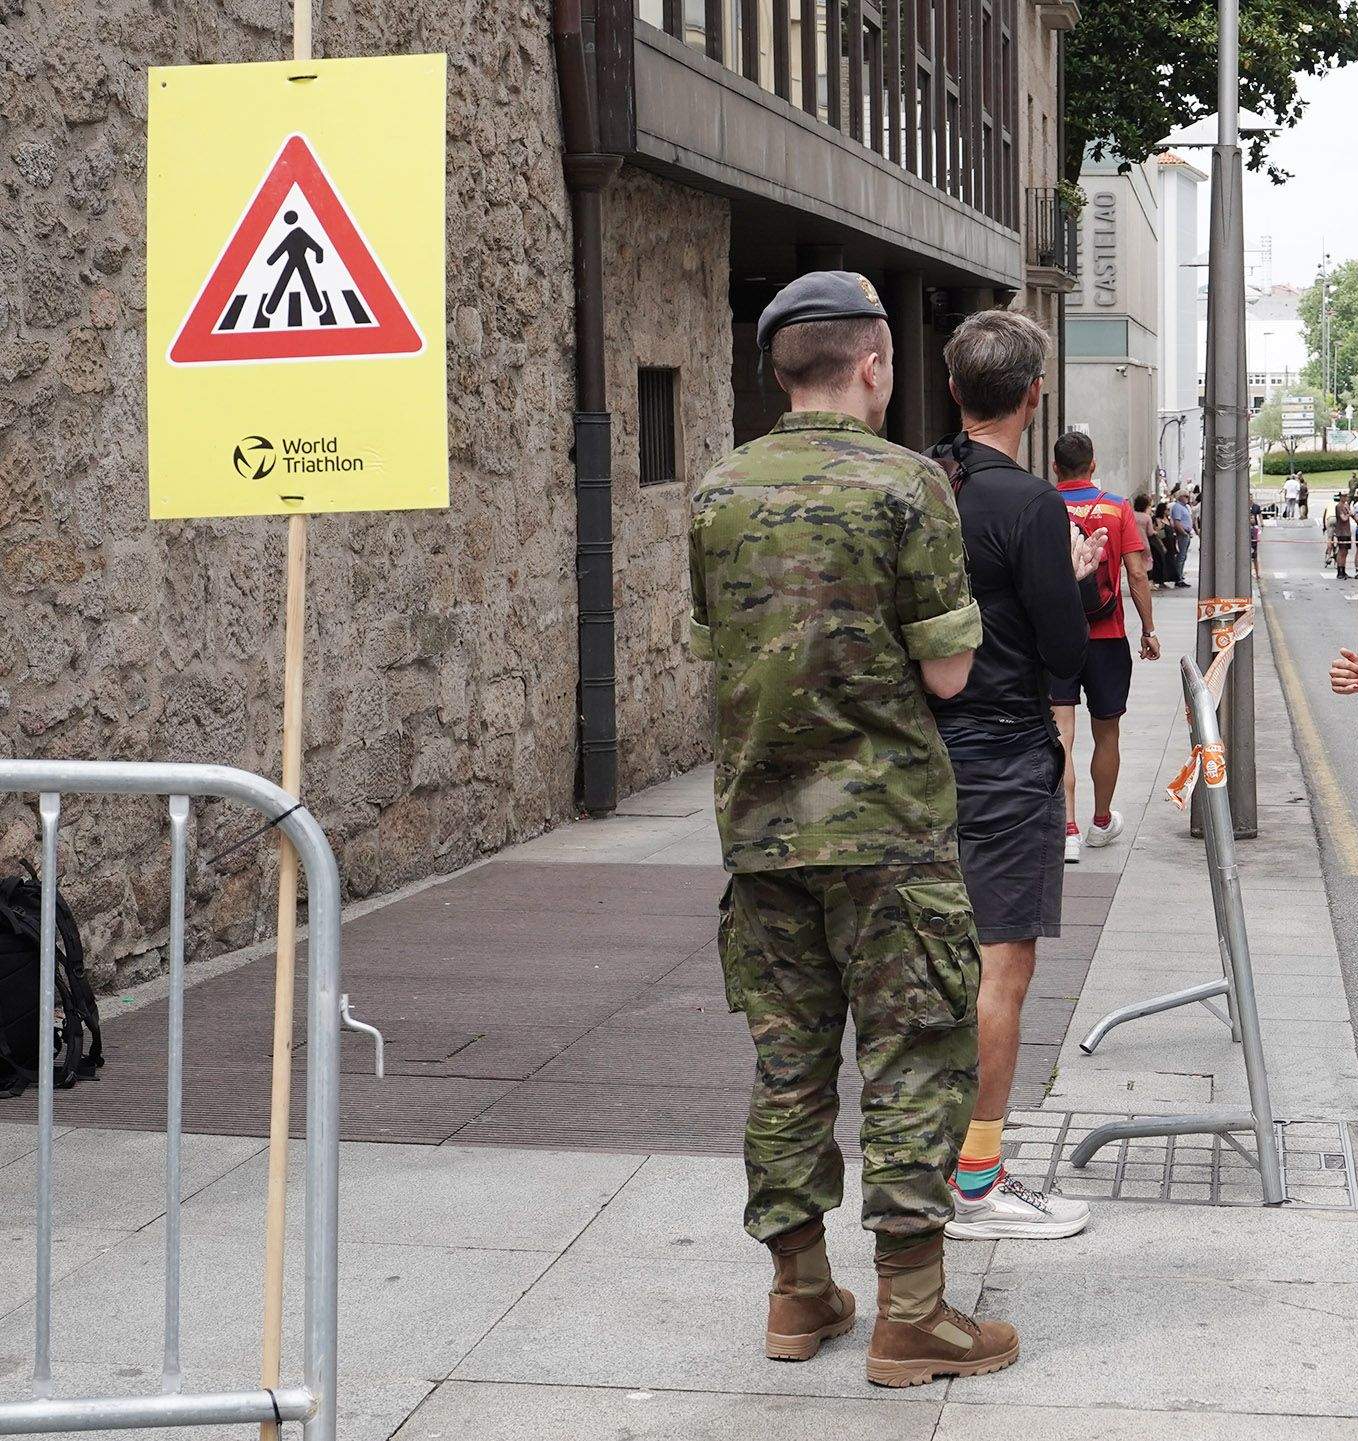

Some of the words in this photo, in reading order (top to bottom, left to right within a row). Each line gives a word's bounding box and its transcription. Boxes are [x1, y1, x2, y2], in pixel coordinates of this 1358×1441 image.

[1094, 191, 1116, 307] CASTELAO
[282, 437, 338, 455] World
[282, 455, 364, 473] Triathlon
